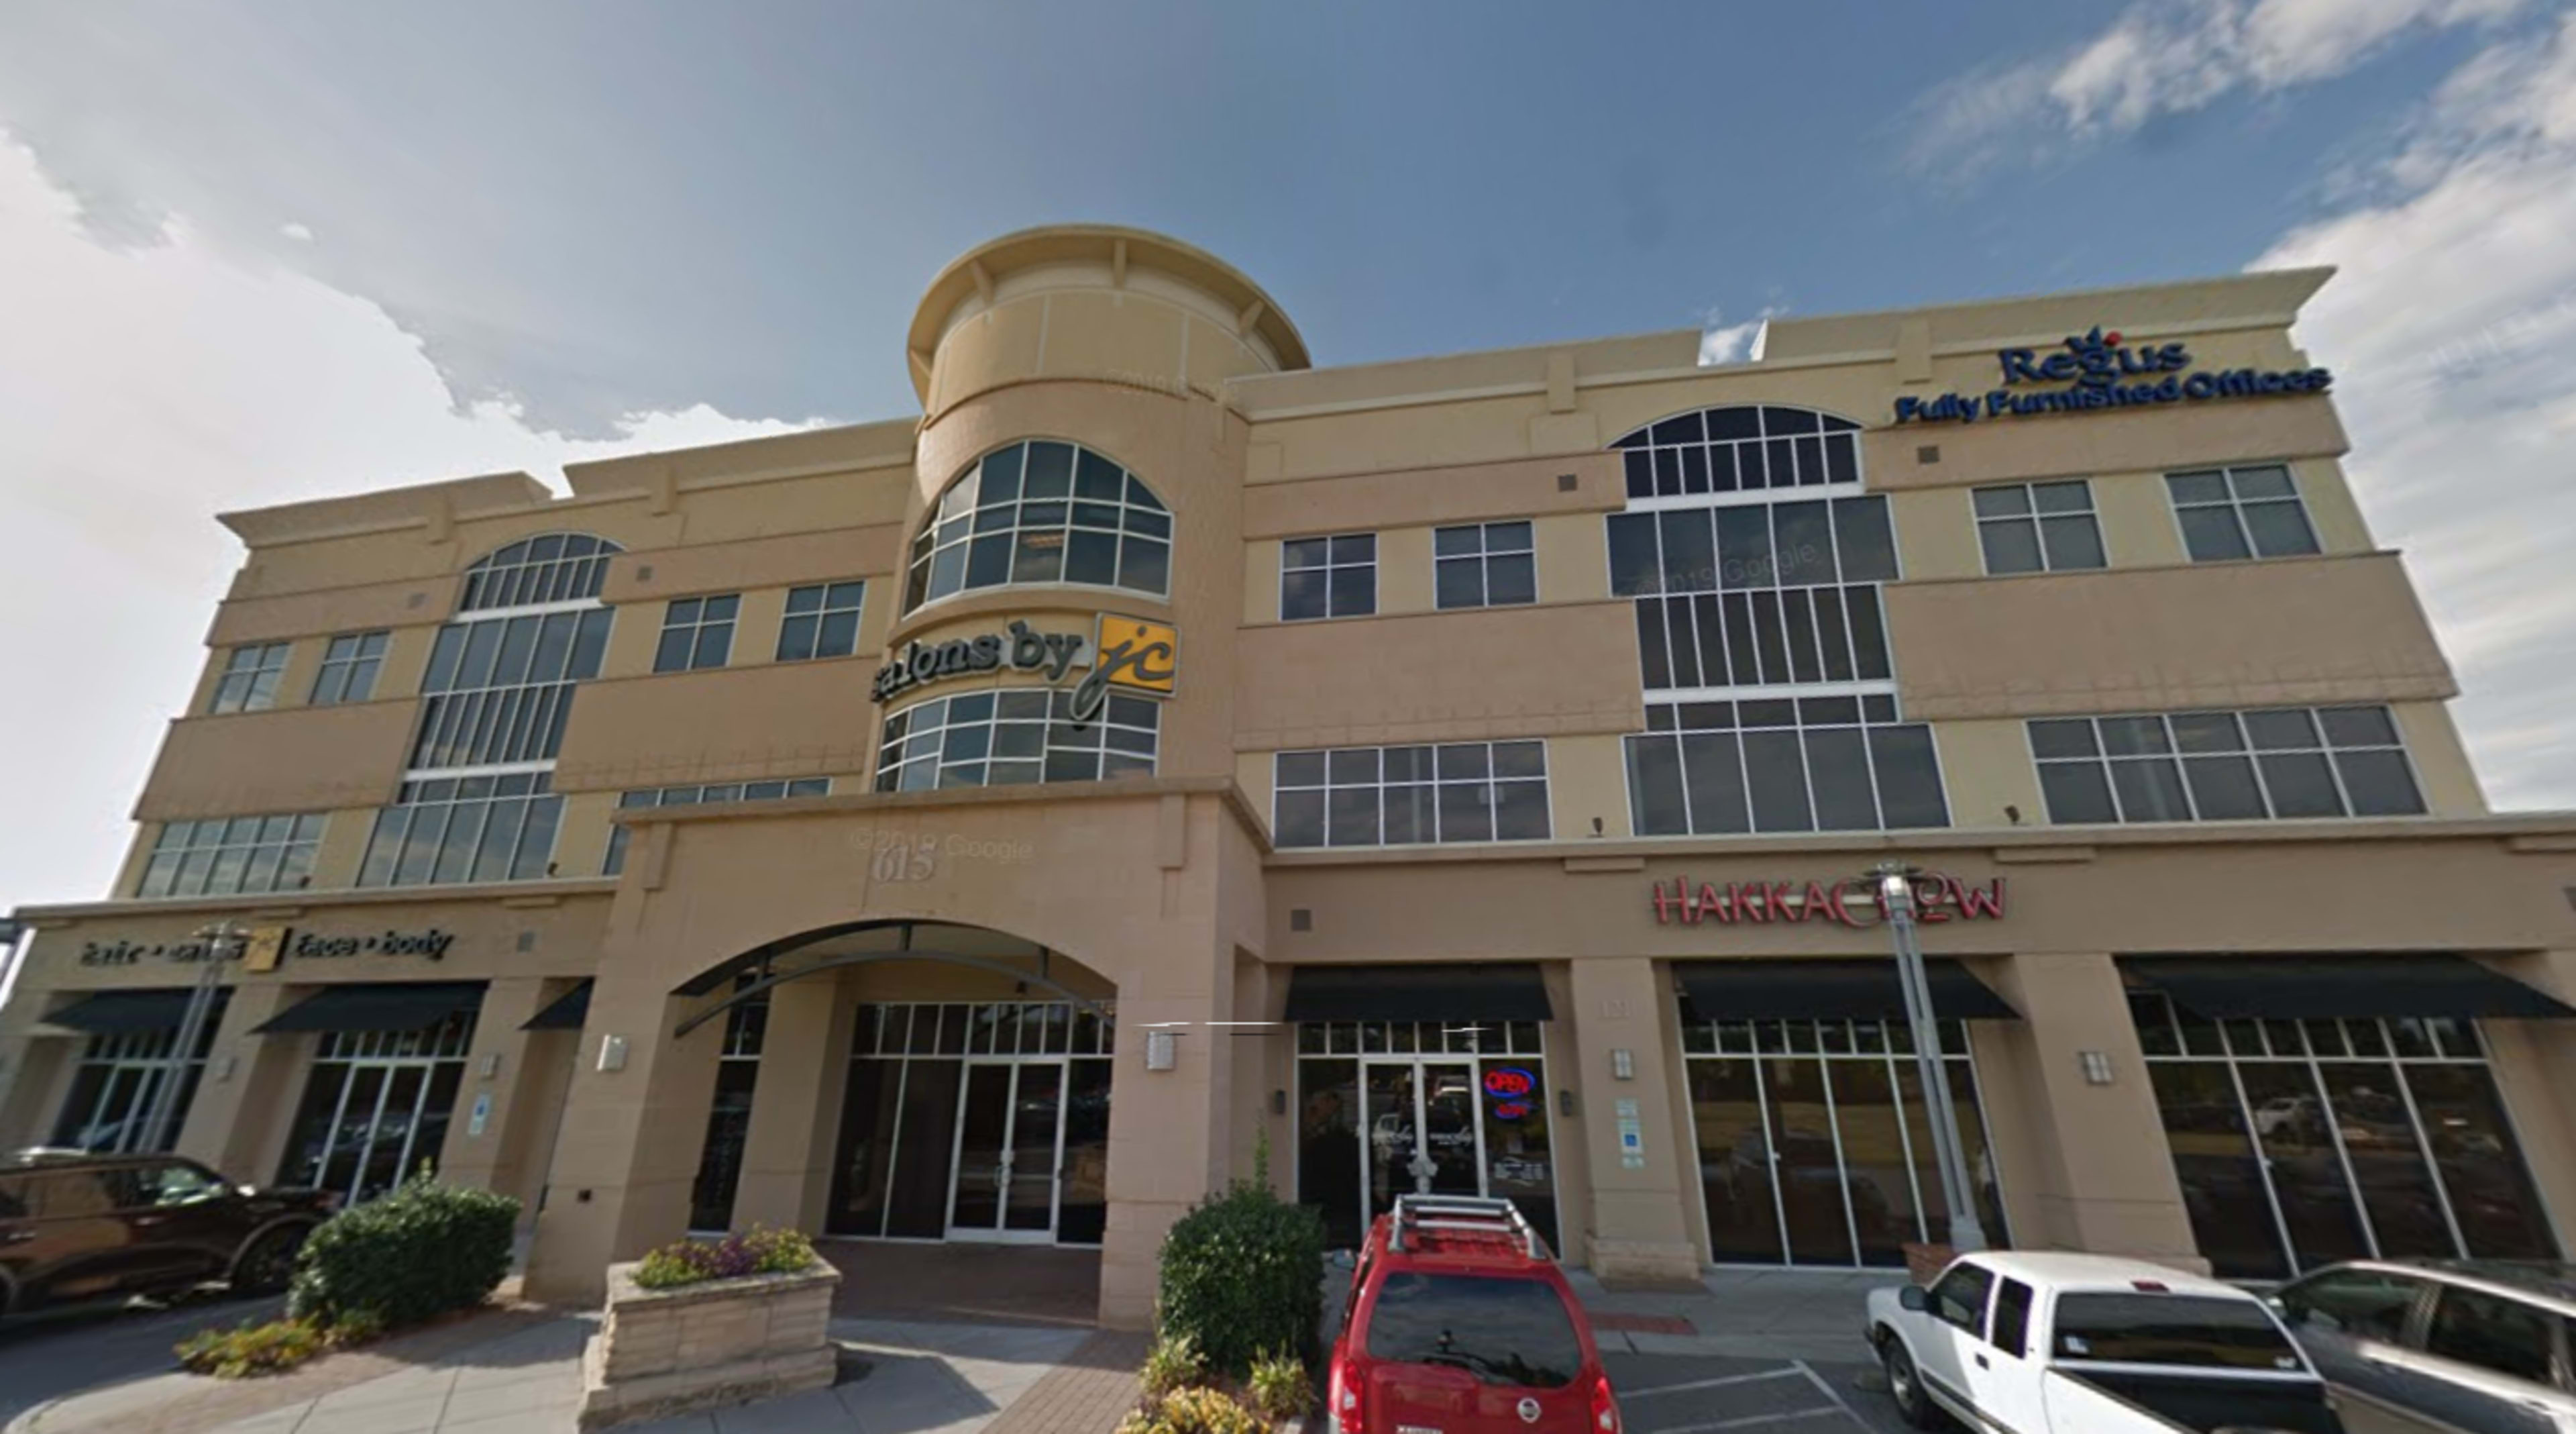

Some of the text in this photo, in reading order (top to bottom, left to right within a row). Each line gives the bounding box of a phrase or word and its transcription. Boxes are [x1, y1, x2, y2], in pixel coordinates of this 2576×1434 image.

[1998, 325, 2192, 388] Regus
[1895, 366, 2334, 424] Fully Furnished Offices
[1009, 619, 1083, 684] by
[1069, 624, 1175, 721] jc
[871, 843, 936, 882] 615
